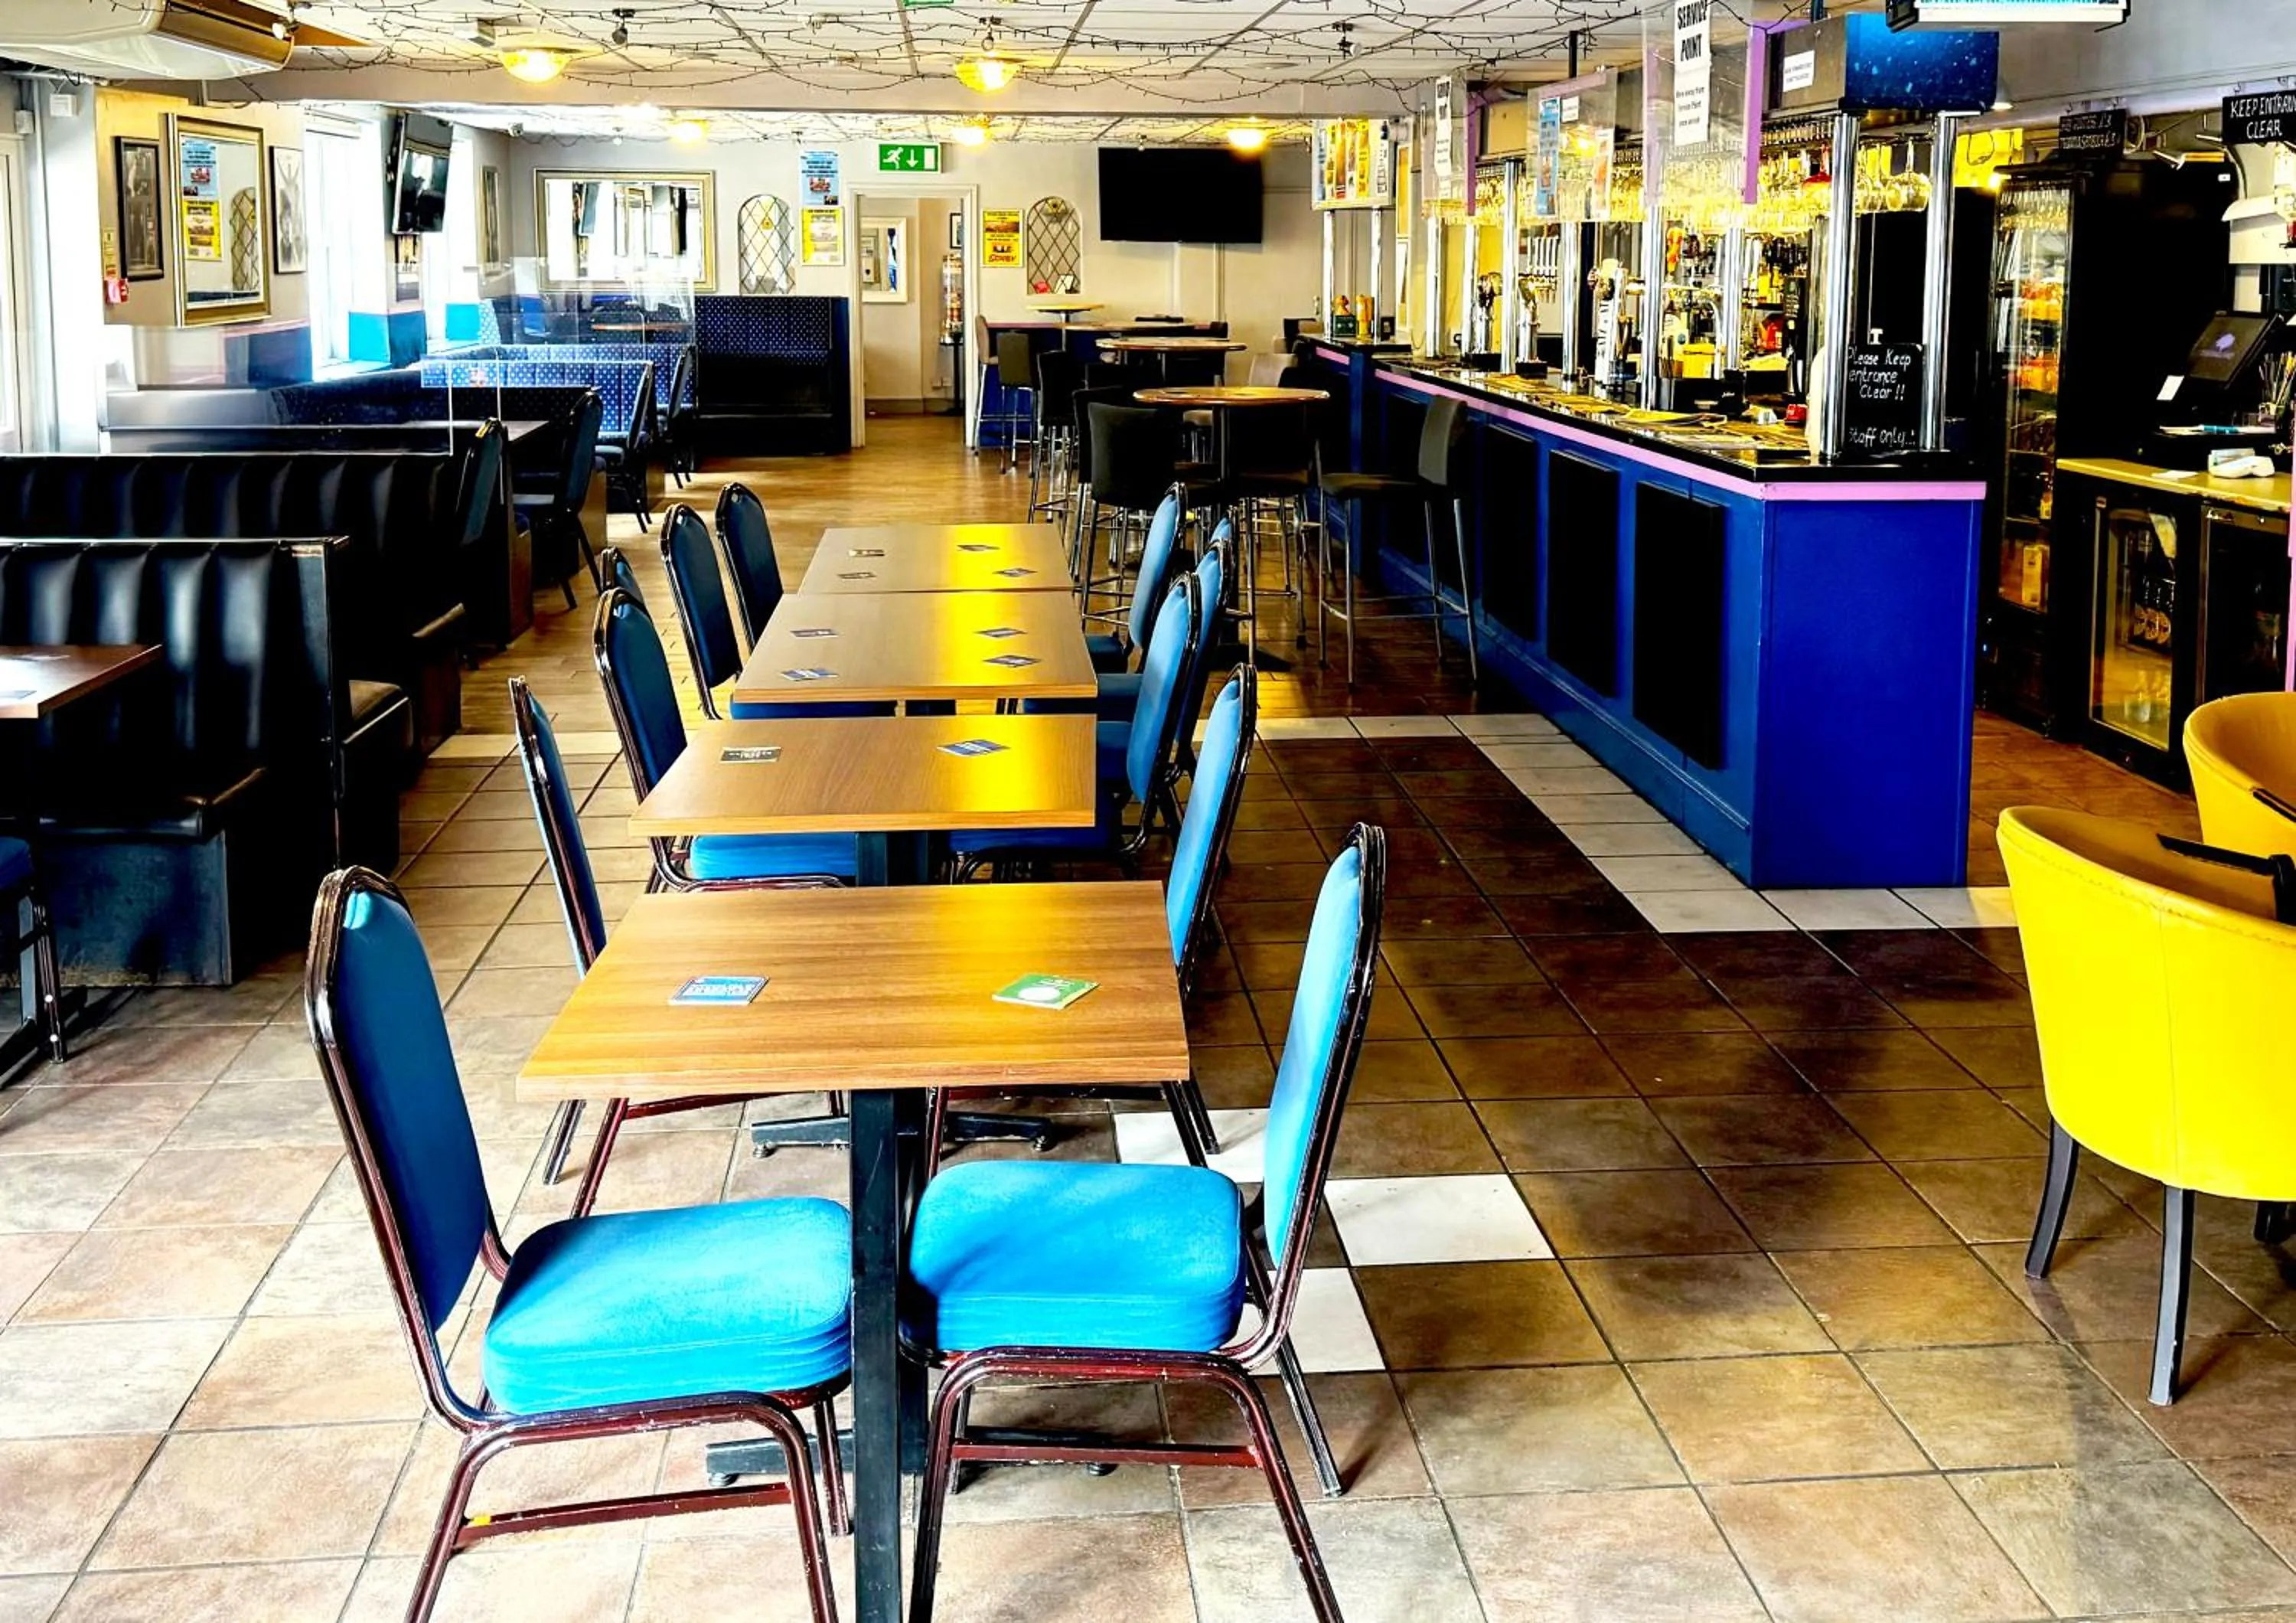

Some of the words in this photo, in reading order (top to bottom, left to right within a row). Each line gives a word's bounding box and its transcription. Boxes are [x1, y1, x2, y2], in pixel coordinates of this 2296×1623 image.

[1678, 0, 1707, 30] SERVICE
[1680, 34, 1702, 61] POINT
[2230, 97, 2258, 118] KEEP
[2246, 119, 2282, 139] CLEAR
[1885, 348, 1911, 371] Keep
[1849, 367, 1898, 386] entrance
